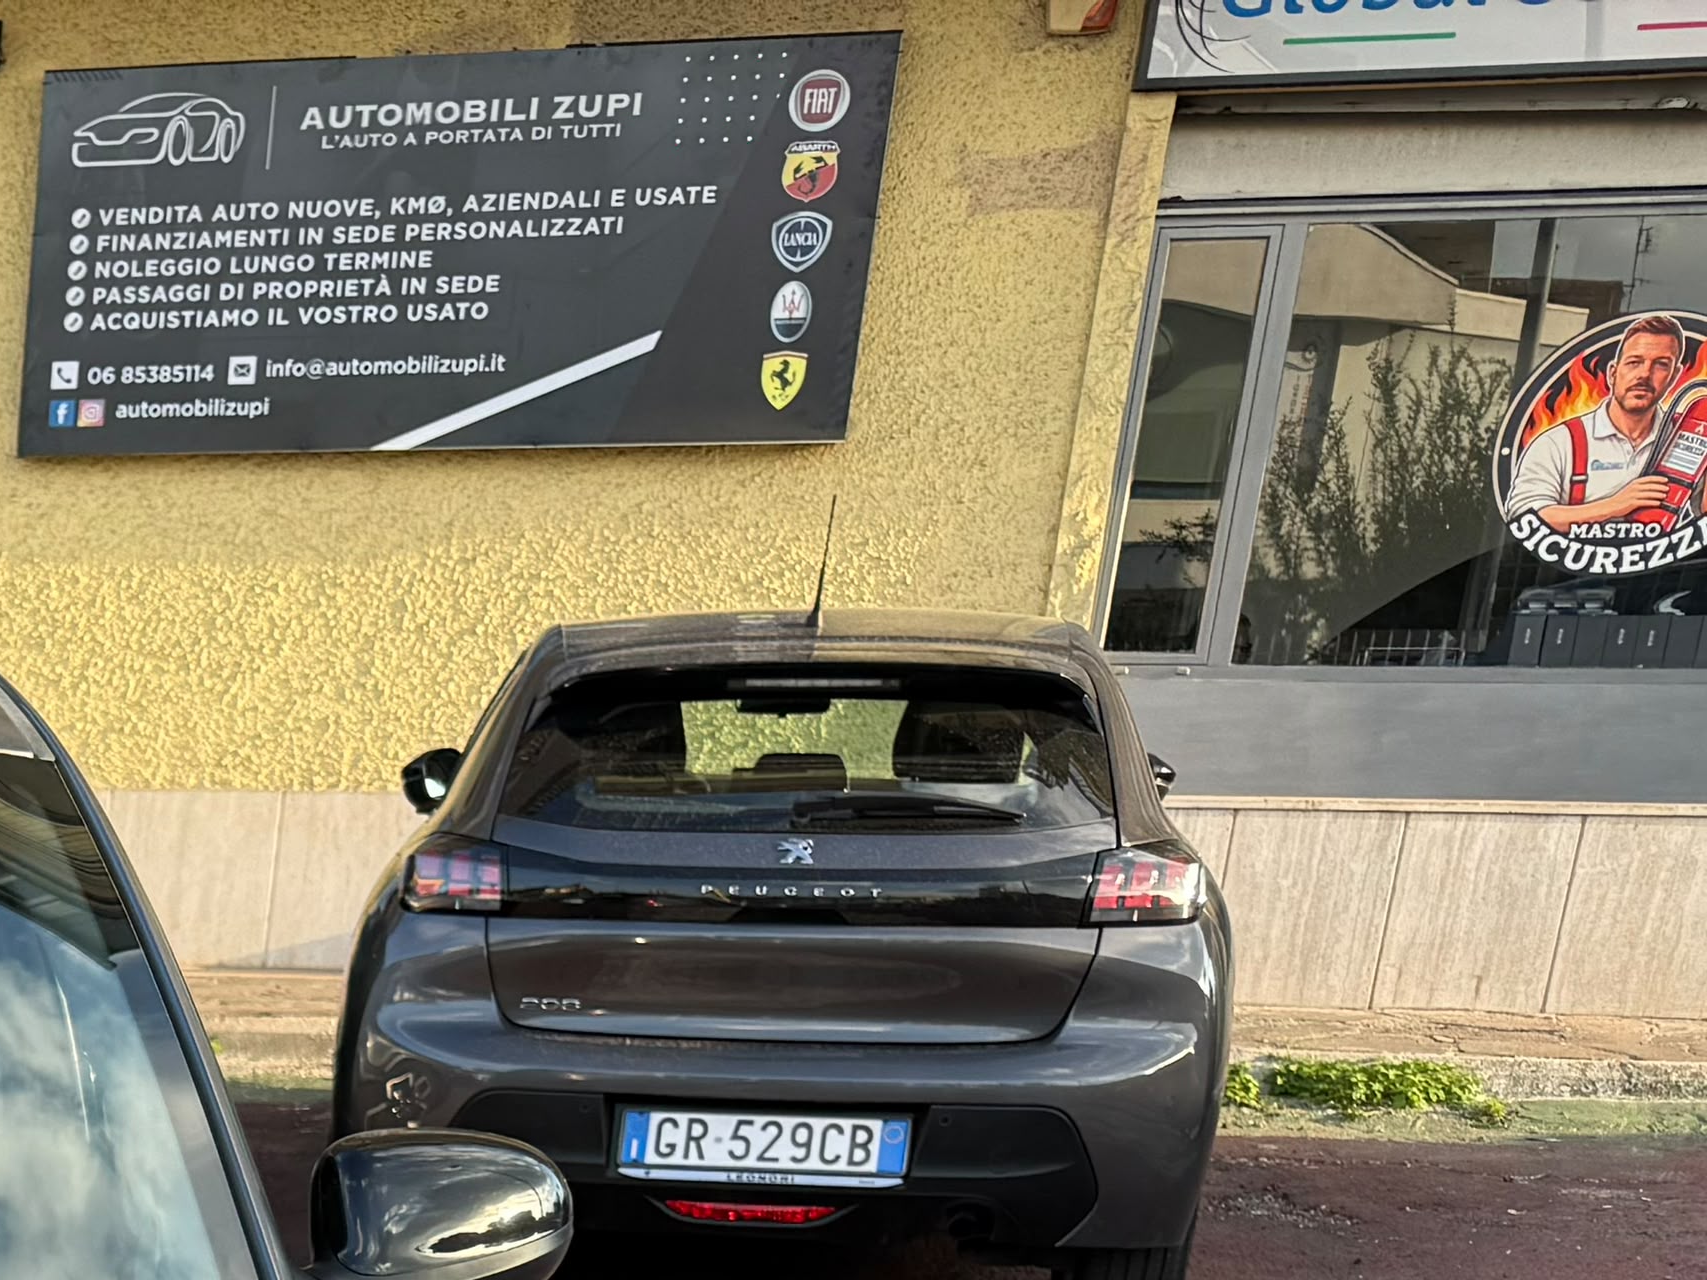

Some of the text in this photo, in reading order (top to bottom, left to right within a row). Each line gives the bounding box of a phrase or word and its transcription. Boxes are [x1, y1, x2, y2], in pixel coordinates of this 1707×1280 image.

[299, 92, 642, 131] AUTOMOBILI ZUPI
[803, 88, 838, 114] FIAT
[321, 123, 621, 150] L'AUTO A PORTATA DI TUTTI
[98, 205, 203, 226] VENDITA
[211, 202, 279, 222] AUTO
[287, 198, 382, 220] NUOVE,
[462, 189, 601, 214] AZIENDALI
[611, 188, 626, 207] E
[635, 185, 718, 206] USATE
[96, 216, 624, 253] FINANZIAMENTI IN SEDE PERSONALIZZATI
[784, 232, 818, 246] LANCIA
[94, 250, 433, 279] NOLEGGIO LUNGO TERMINE
[92, 274, 501, 305] PASSAGGI DI PROPRIETÀ IN SEDE
[90, 301, 489, 332] ACQUISTIAMO IL VOSTRO USATO
[87, 353, 506, 385] 06 85385114 info@automobilizupi.it
[115, 397, 271, 420] automobilizupi
[1568, 522, 1662, 539] MASTRO
[700, 884, 882, 898] PEUGEOT
[653, 1117, 710, 1160] GR
[727, 1119, 874, 1167] 529CB
